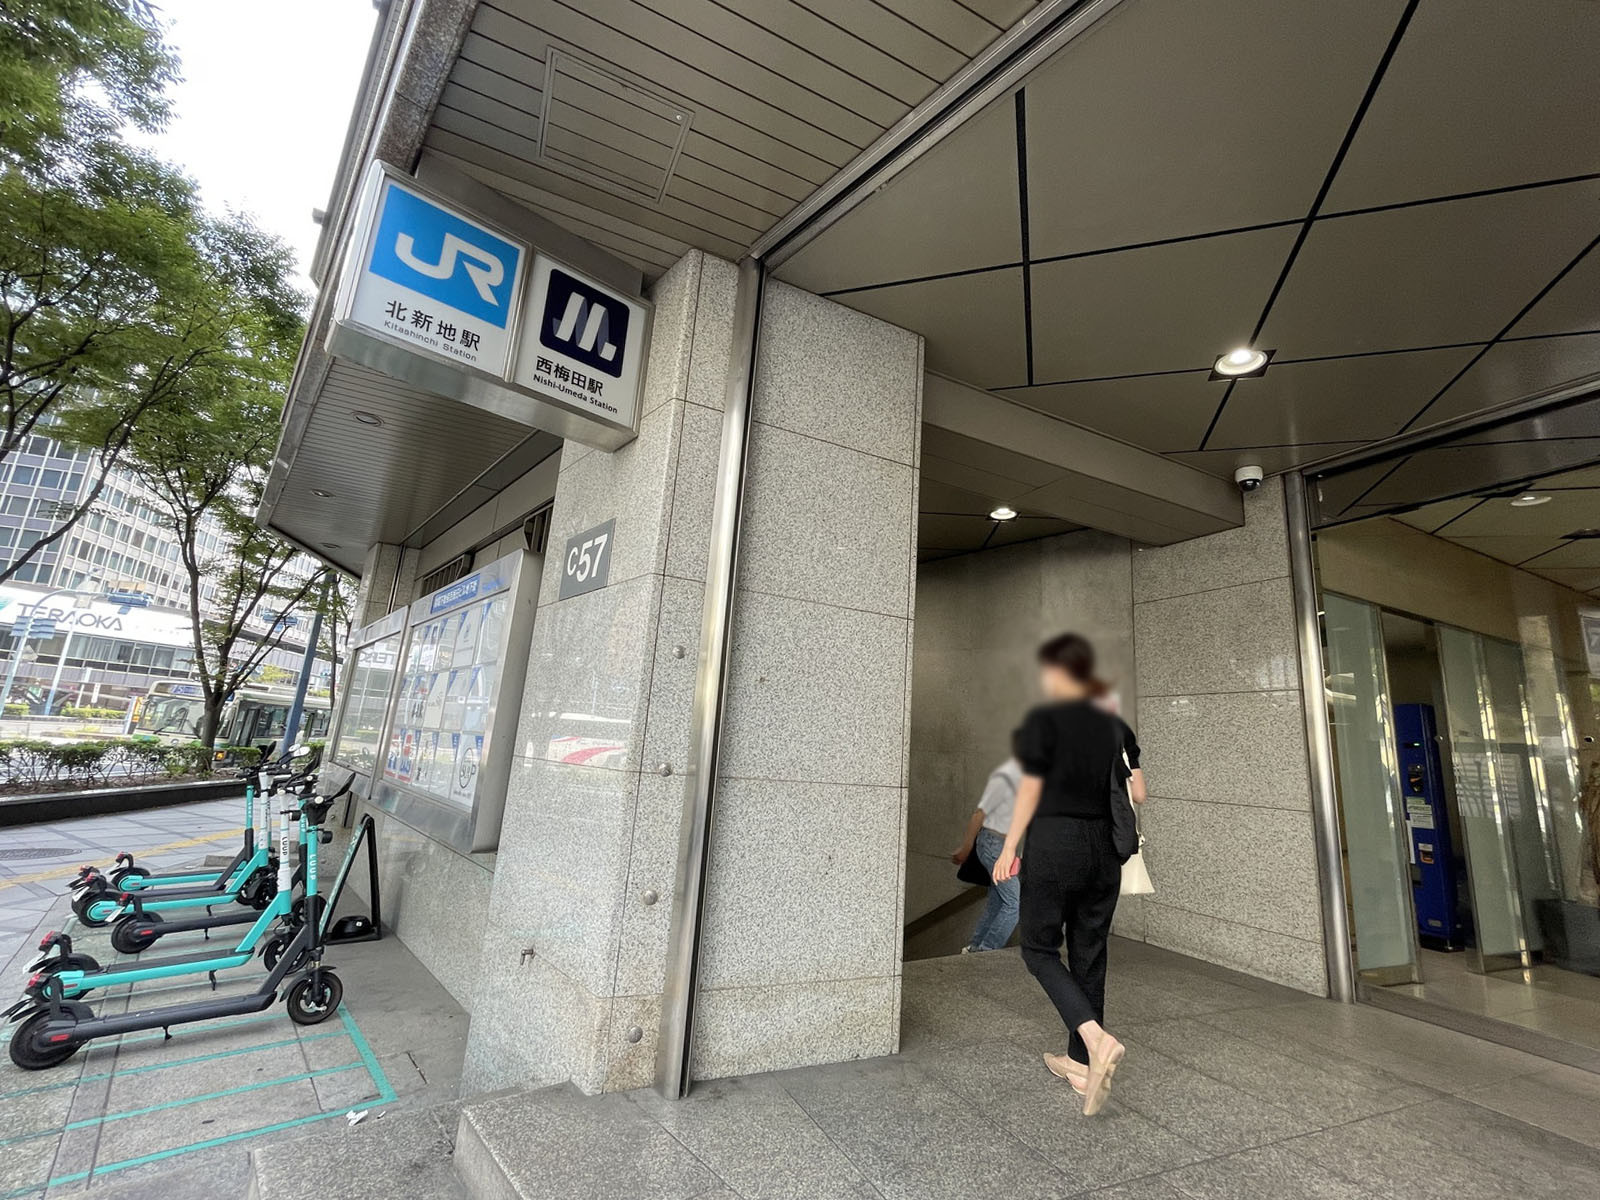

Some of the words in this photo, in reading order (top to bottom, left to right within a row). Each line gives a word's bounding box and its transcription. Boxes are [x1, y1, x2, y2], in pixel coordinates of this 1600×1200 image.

[394, 231, 505, 307] JR
[383, 320, 439, 348] Kitashinchi
[442, 342, 478, 363] Station
[385, 300, 481, 352] 北新地駅
[533, 373, 588, 403] Nishi-Umeda
[588, 396, 619, 414] Station
[535, 355, 604, 397] 西梅田駅
[567, 533, 608, 583] C57
[309, 854, 318, 881] LUUP
